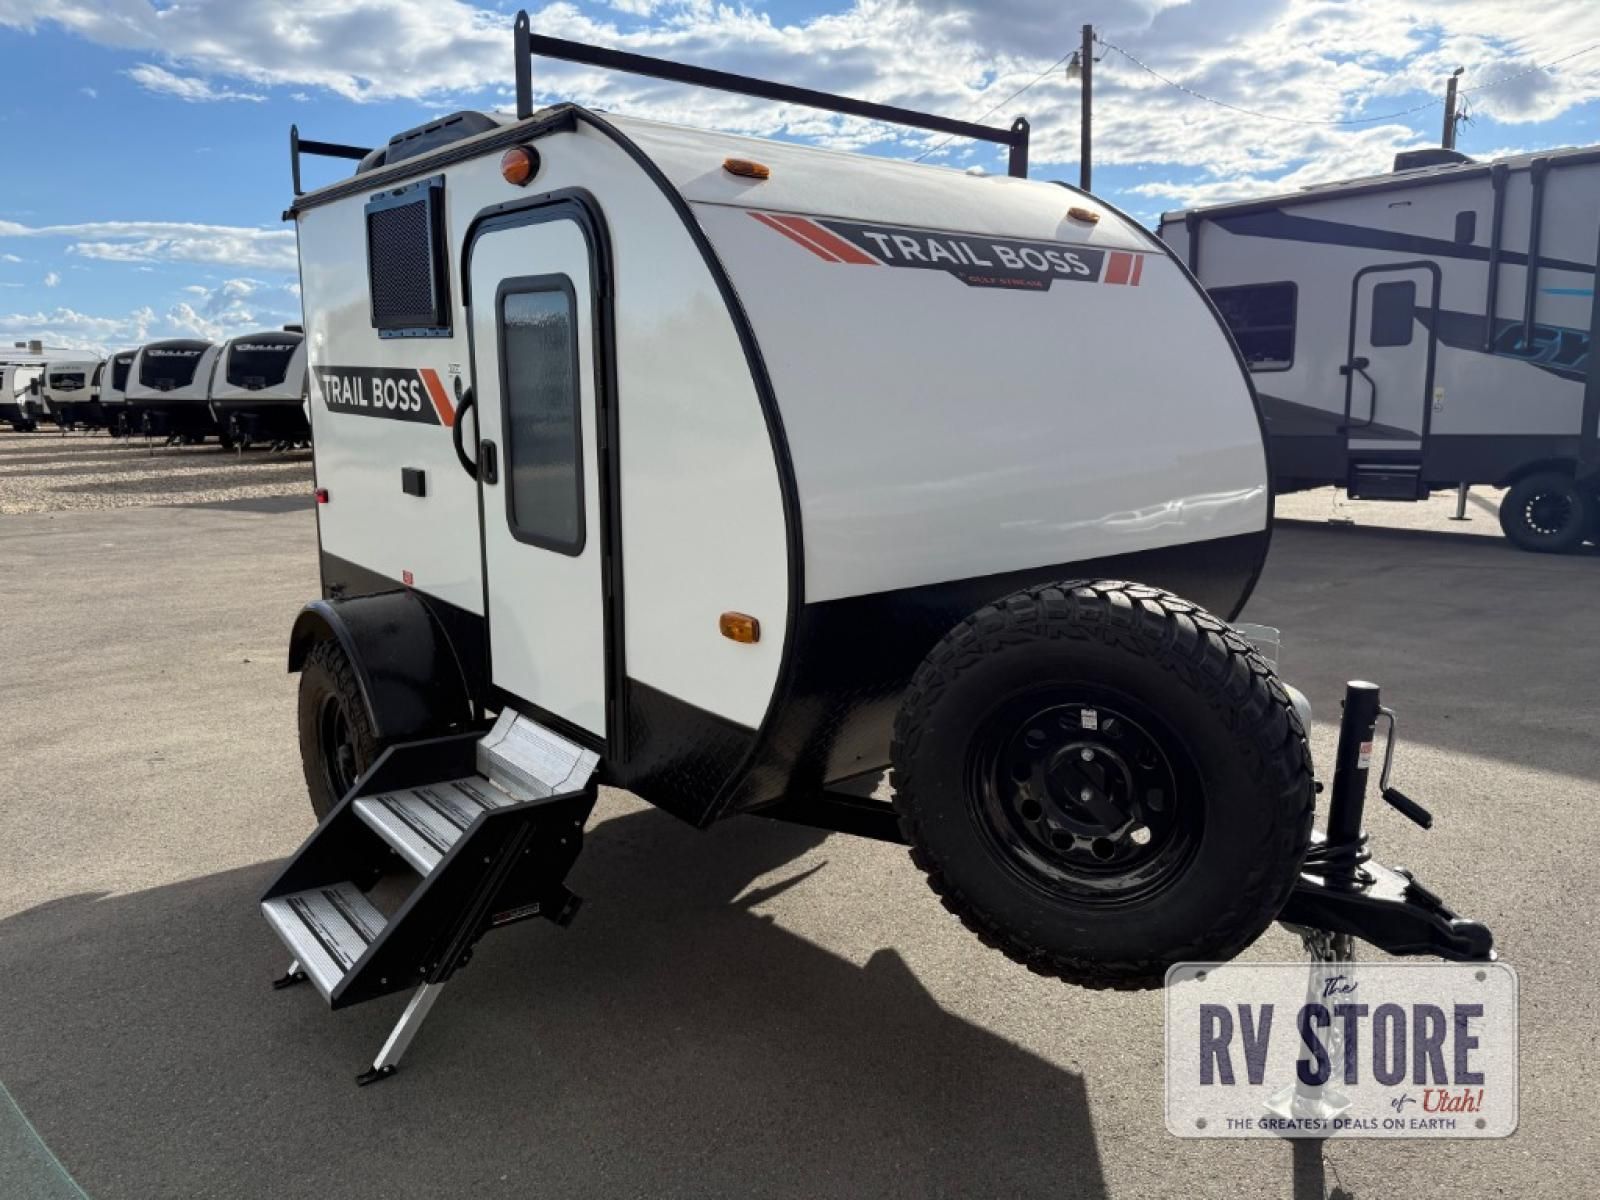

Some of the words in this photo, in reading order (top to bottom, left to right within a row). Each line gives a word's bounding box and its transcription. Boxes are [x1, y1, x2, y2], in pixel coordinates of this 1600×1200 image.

[862, 231, 993, 267] TRAIL
[993, 245, 1091, 277] BOSS
[322, 374, 368, 407] TRAIL
[372, 377, 421, 412] BOSS
